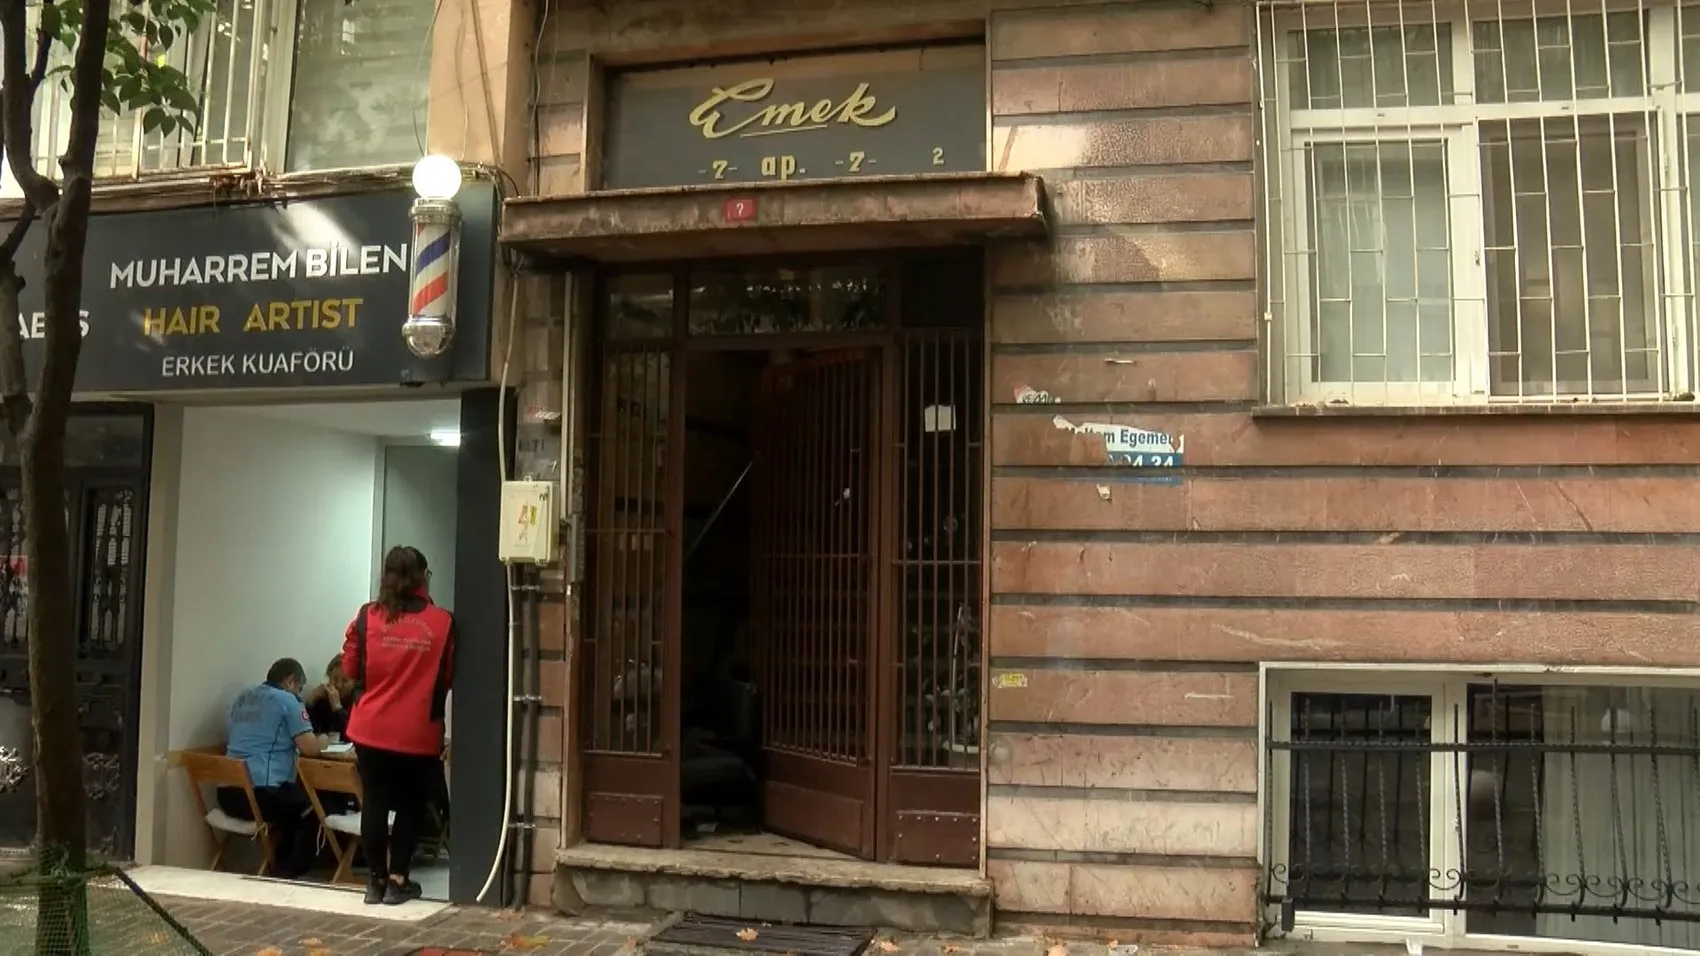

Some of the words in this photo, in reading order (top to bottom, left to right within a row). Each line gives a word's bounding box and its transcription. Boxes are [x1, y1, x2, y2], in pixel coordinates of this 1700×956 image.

[689, 78, 896, 138] Emek
[932, 147, 945, 165] 2
[109, 250, 299, 289] MUHARREM
[305, 240, 408, 278] BİLEN
[144, 304, 221, 337] HAIR
[243, 298, 364, 333] ARTIST
[162, 354, 236, 378] ERKEK
[242, 346, 354, 374] KUAFÖRÜ
